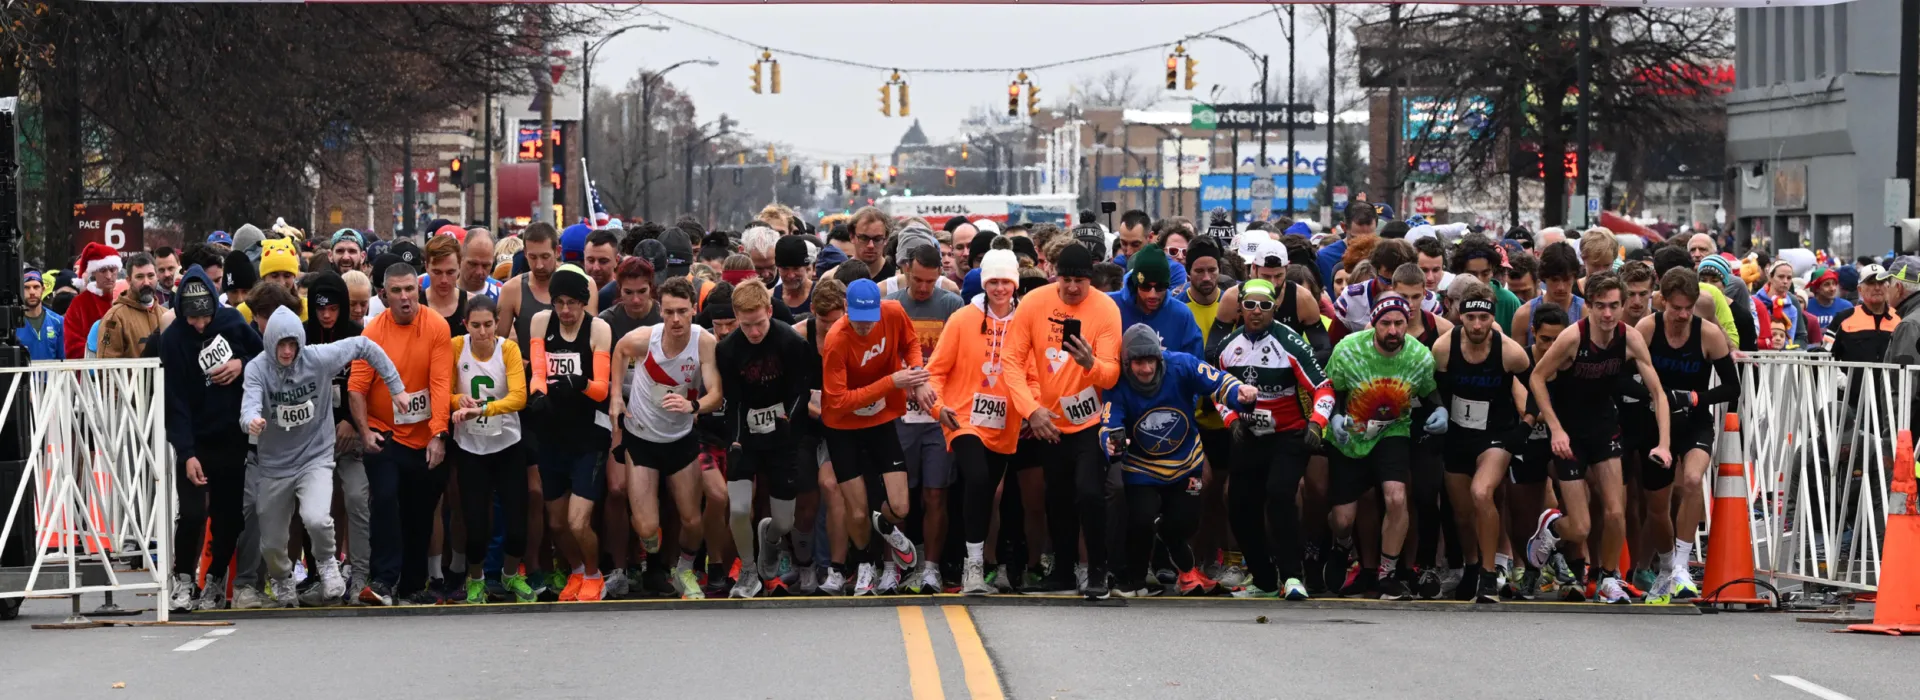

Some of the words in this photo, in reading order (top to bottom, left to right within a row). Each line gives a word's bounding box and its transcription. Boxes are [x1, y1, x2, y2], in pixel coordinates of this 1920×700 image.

[79, 220, 100, 229] PACE
[104, 218, 126, 250] 6
[1870, 264, 1878, 272] C
[1465, 300, 1491, 310] BUFFALO
[1050, 323, 1064, 333] Turk
[199, 339, 230, 371] 12067
[549, 358, 575, 375] 2750
[269, 381, 316, 403] NICHOLS
[1258, 384, 1283, 393] AGO
[282, 406, 311, 423] 4601
[972, 398, 1006, 418] 12948
[1066, 397, 1097, 421] 14187
[1464, 404, 1472, 418] 1
[753, 410, 778, 426] 1741
